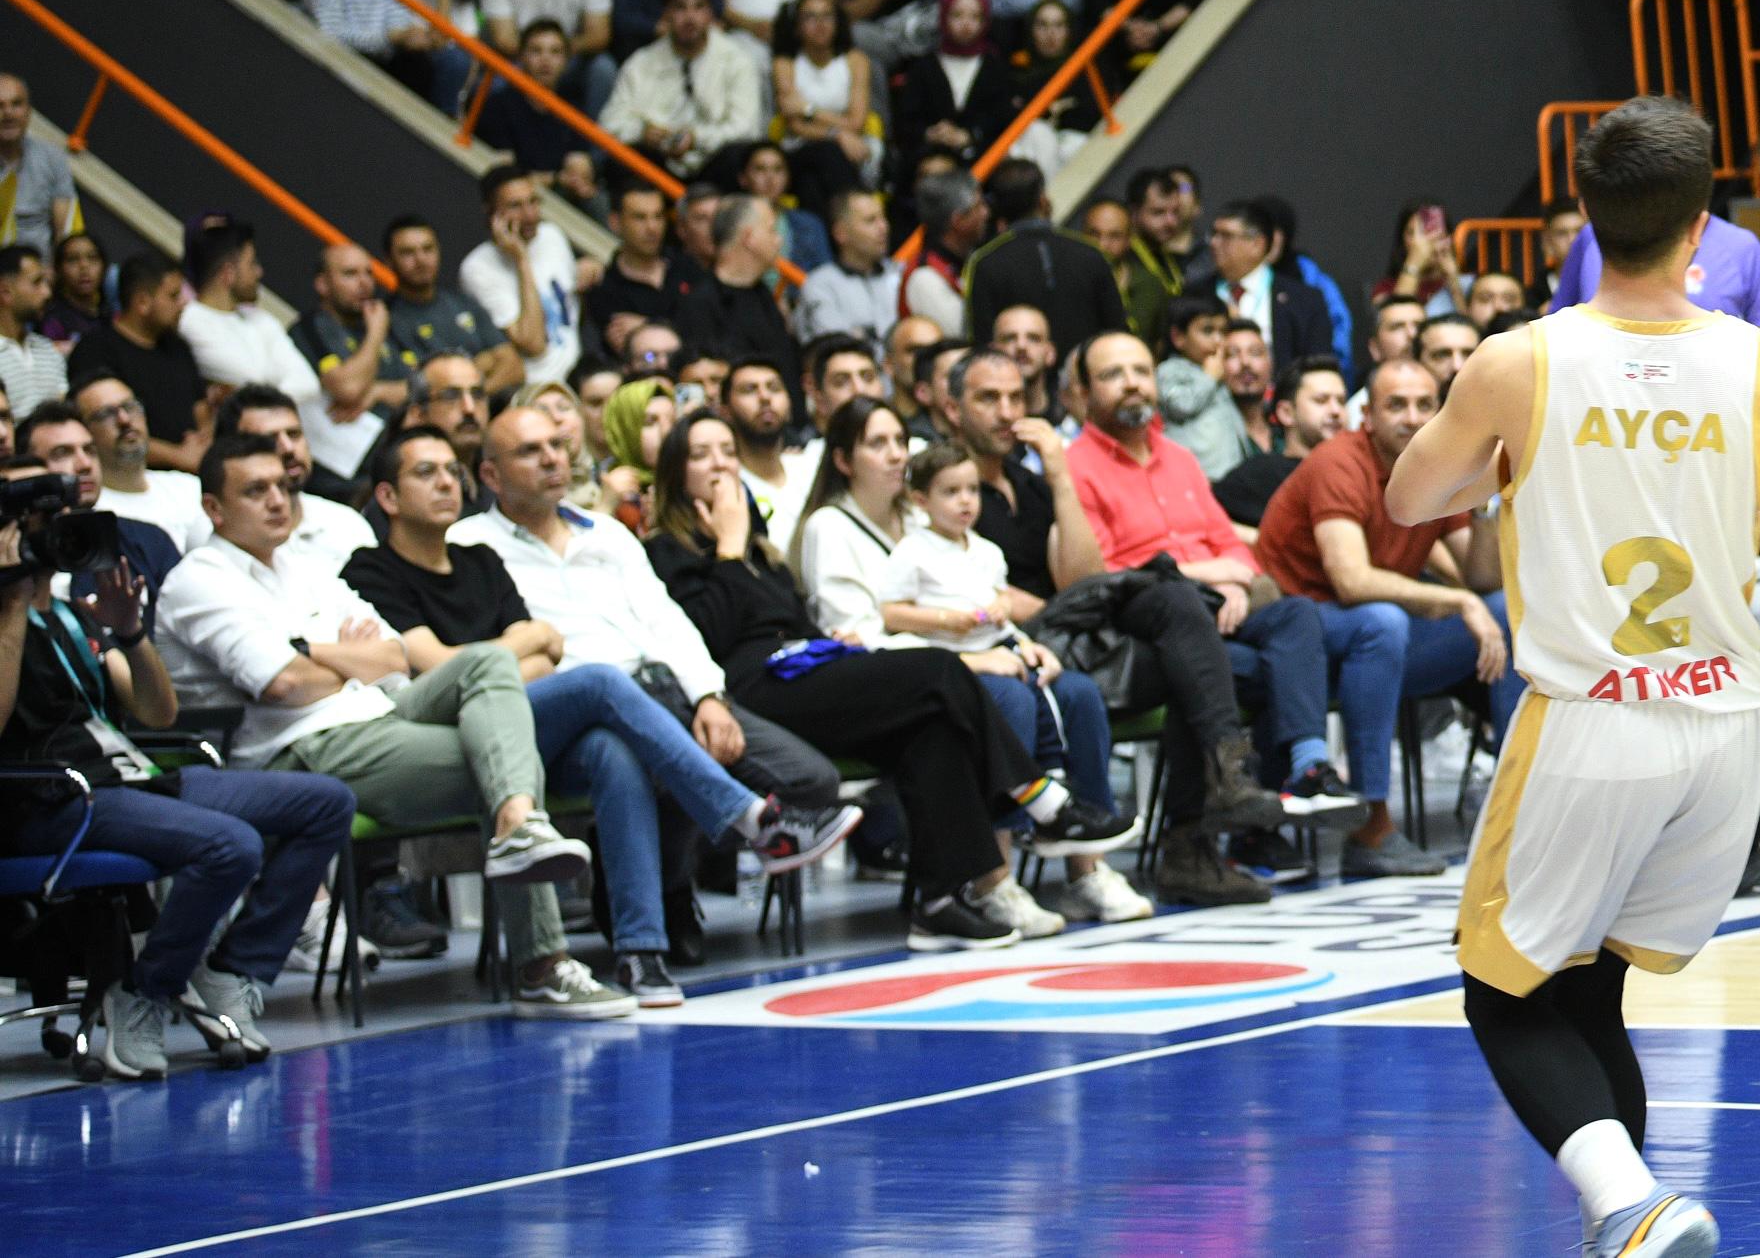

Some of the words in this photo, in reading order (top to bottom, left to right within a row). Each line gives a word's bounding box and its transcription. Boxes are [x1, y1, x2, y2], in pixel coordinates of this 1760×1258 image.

[1573, 406, 1727, 464] AYÇA
[1602, 536, 1694, 656] 2
[1588, 655, 1740, 703] ATIKER
